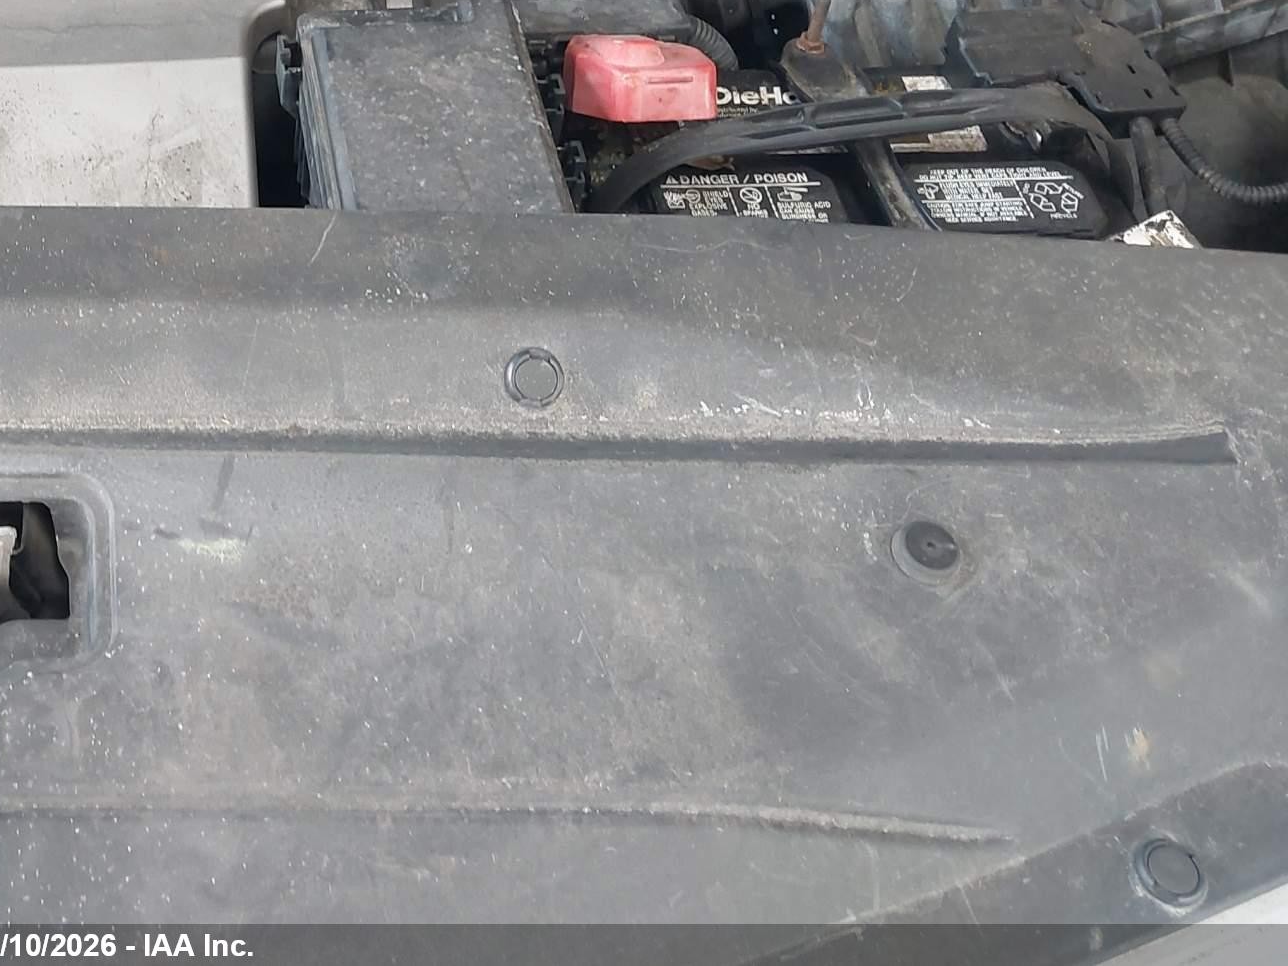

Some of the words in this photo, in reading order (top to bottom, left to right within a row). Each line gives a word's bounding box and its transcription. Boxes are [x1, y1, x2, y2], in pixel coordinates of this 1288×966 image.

[679, 174, 739, 185] DANGER
[743, 174, 750, 184] /
[754, 172, 808, 184] POISON
[702, 190, 729, 198] SHIELD
[689, 202, 728, 210] EXPLOSIVE
[747, 202, 761, 210] NO
[777, 201, 812, 209] SULFURIC
[814, 201, 831, 209] ACID
